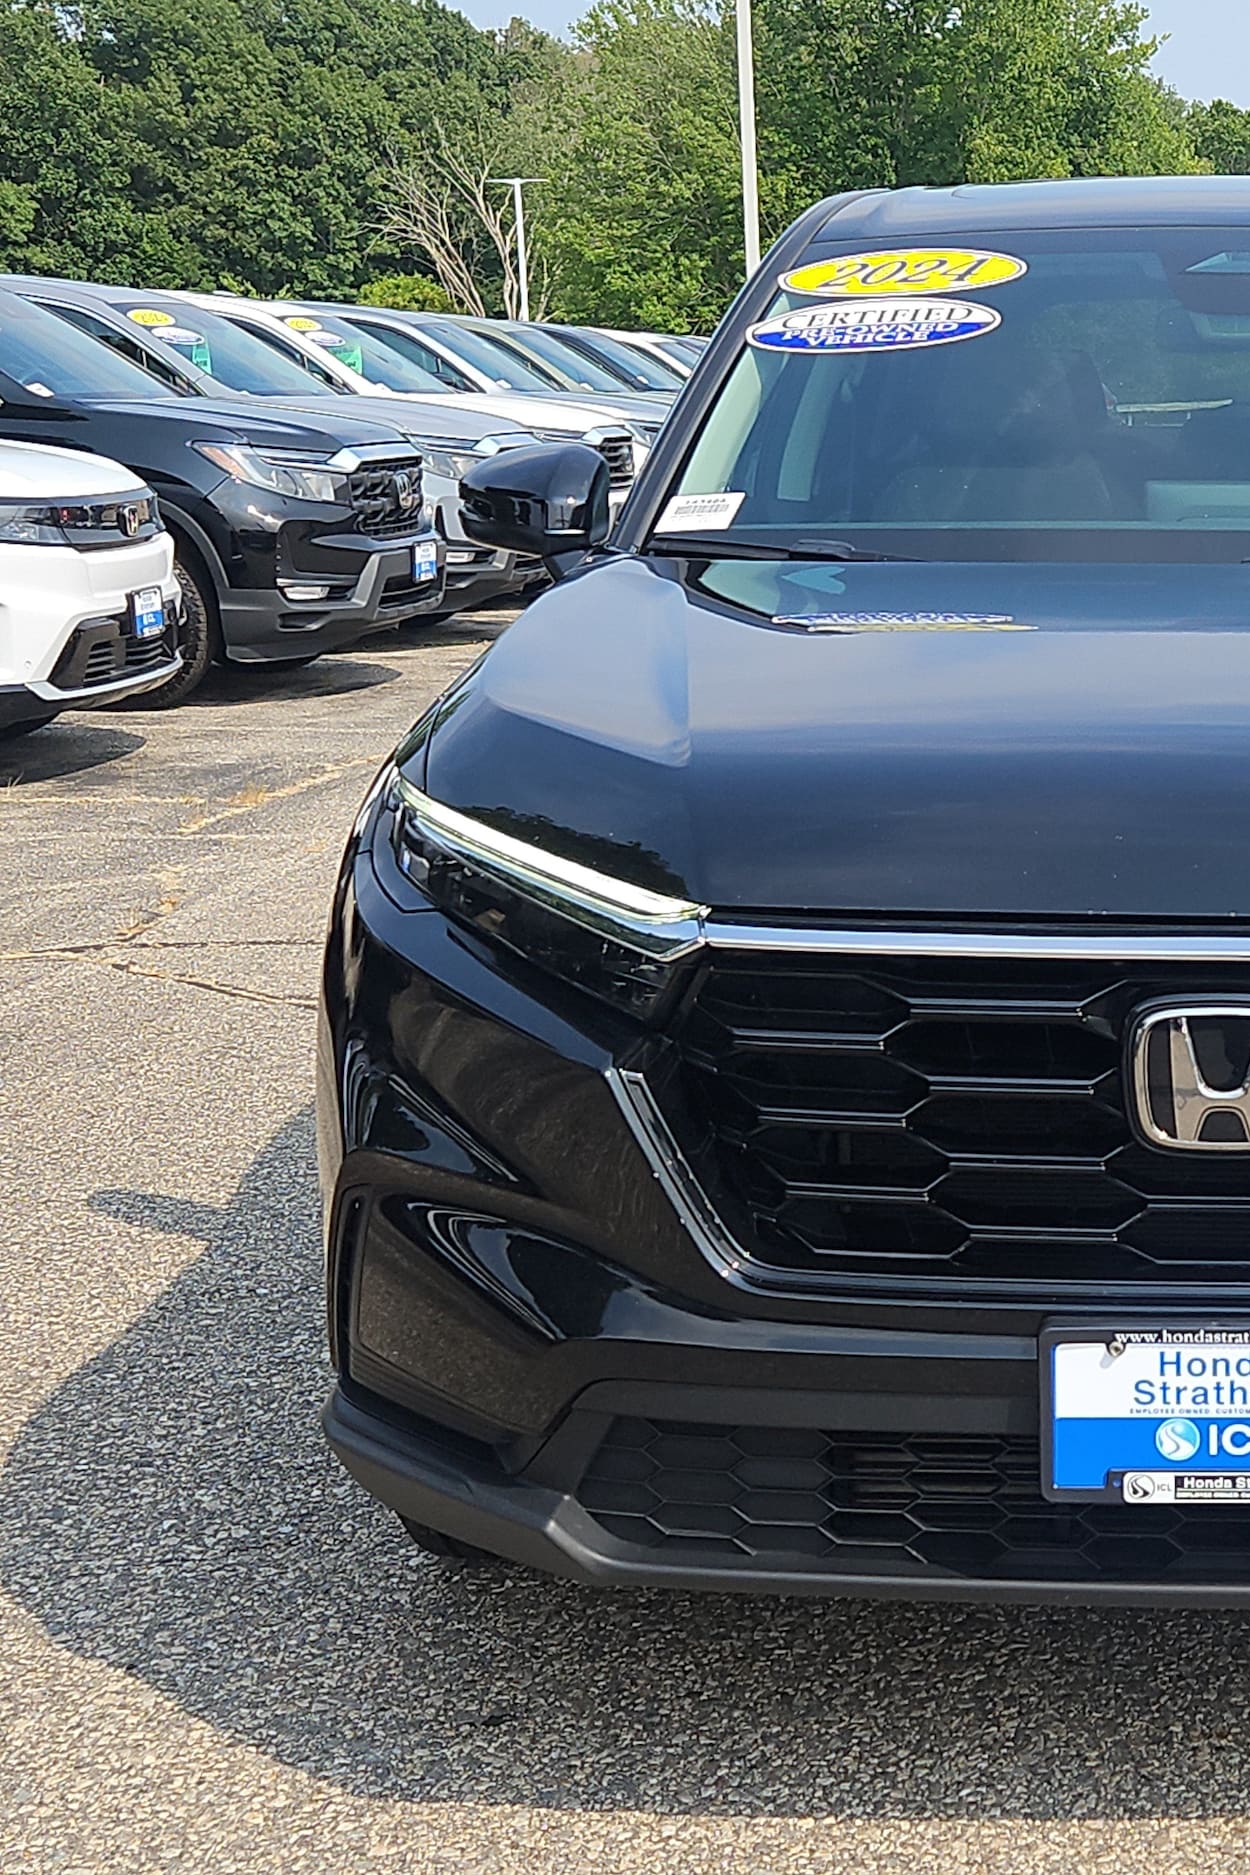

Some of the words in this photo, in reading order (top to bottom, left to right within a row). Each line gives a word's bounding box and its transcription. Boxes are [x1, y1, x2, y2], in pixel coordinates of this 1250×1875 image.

[816, 256, 992, 288] 2024
[782, 307, 973, 330] CERTIFIED
[782, 322, 959, 340] PRE-OWNED
[805, 331, 931, 346] VEHICLE
[1183, 1476, 1232, 1489] Honda
